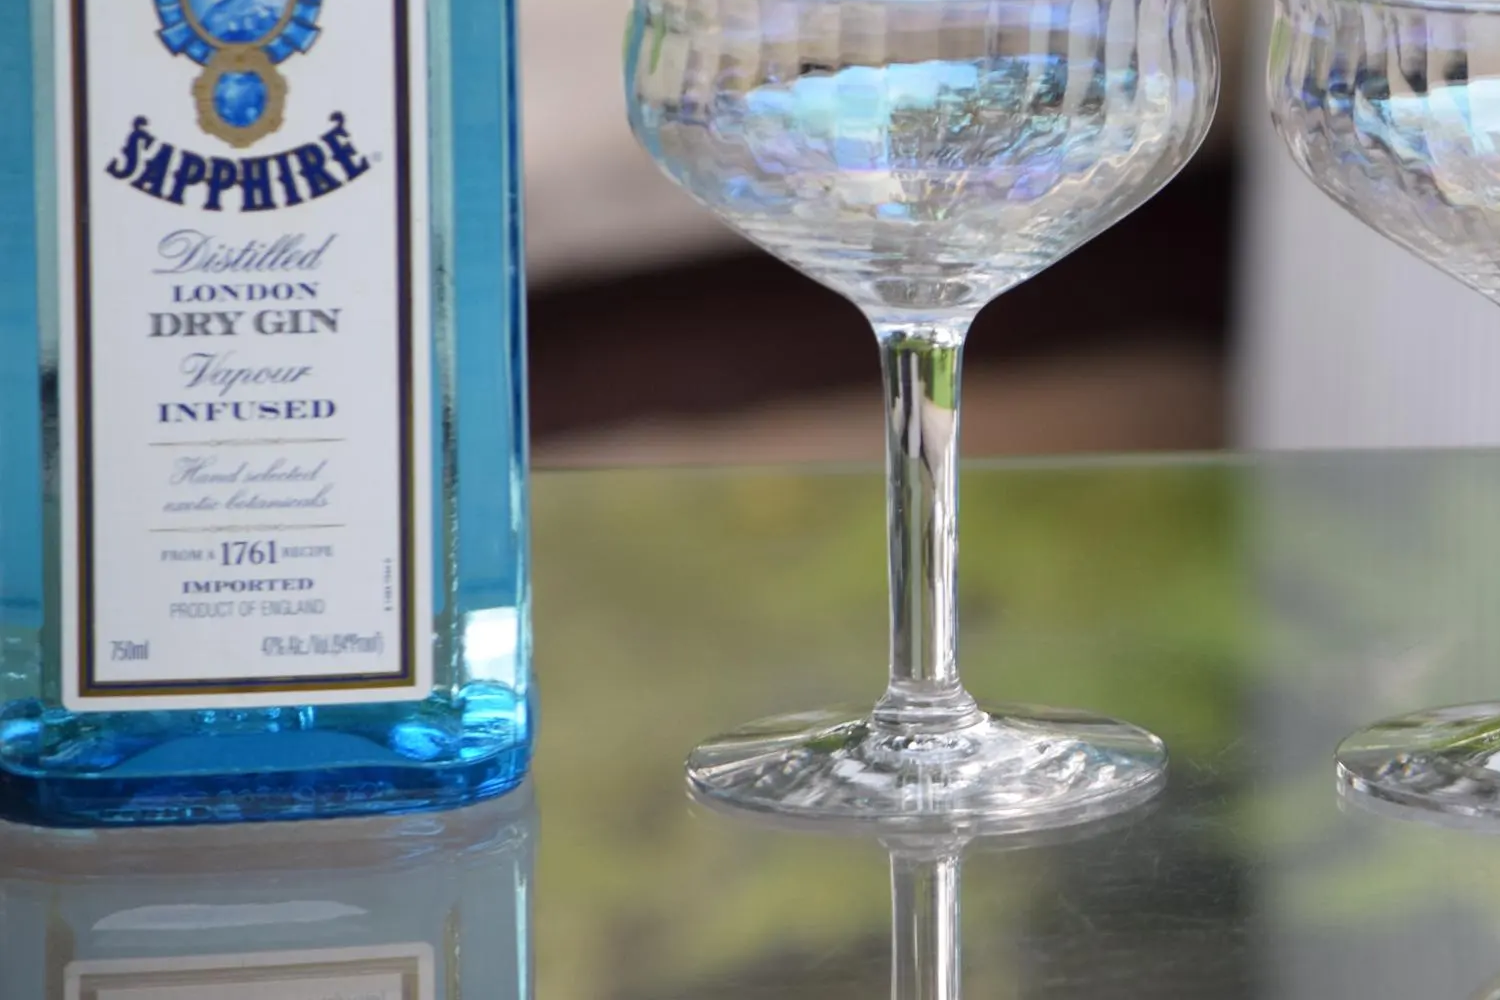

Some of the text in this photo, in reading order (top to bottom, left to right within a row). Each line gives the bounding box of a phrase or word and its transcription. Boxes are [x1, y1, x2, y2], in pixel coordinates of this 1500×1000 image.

[105, 111, 370, 212] SAPPHIRE
[151, 229, 338, 274] Distilled
[172, 282, 320, 303] LONDON
[148, 308, 342, 338] DRY GIN
[180, 350, 313, 397] Vapour
[158, 399, 337, 423] INFUSED
[169, 454, 329, 485] Hand selected
[160, 549, 203, 562] FROM
[220, 539, 278, 566] 1761
[182, 578, 315, 594] IMPORTED
[169, 599, 326, 619] PRODUCT OF ENGLAND
[109, 639, 149, 661] 750ml
